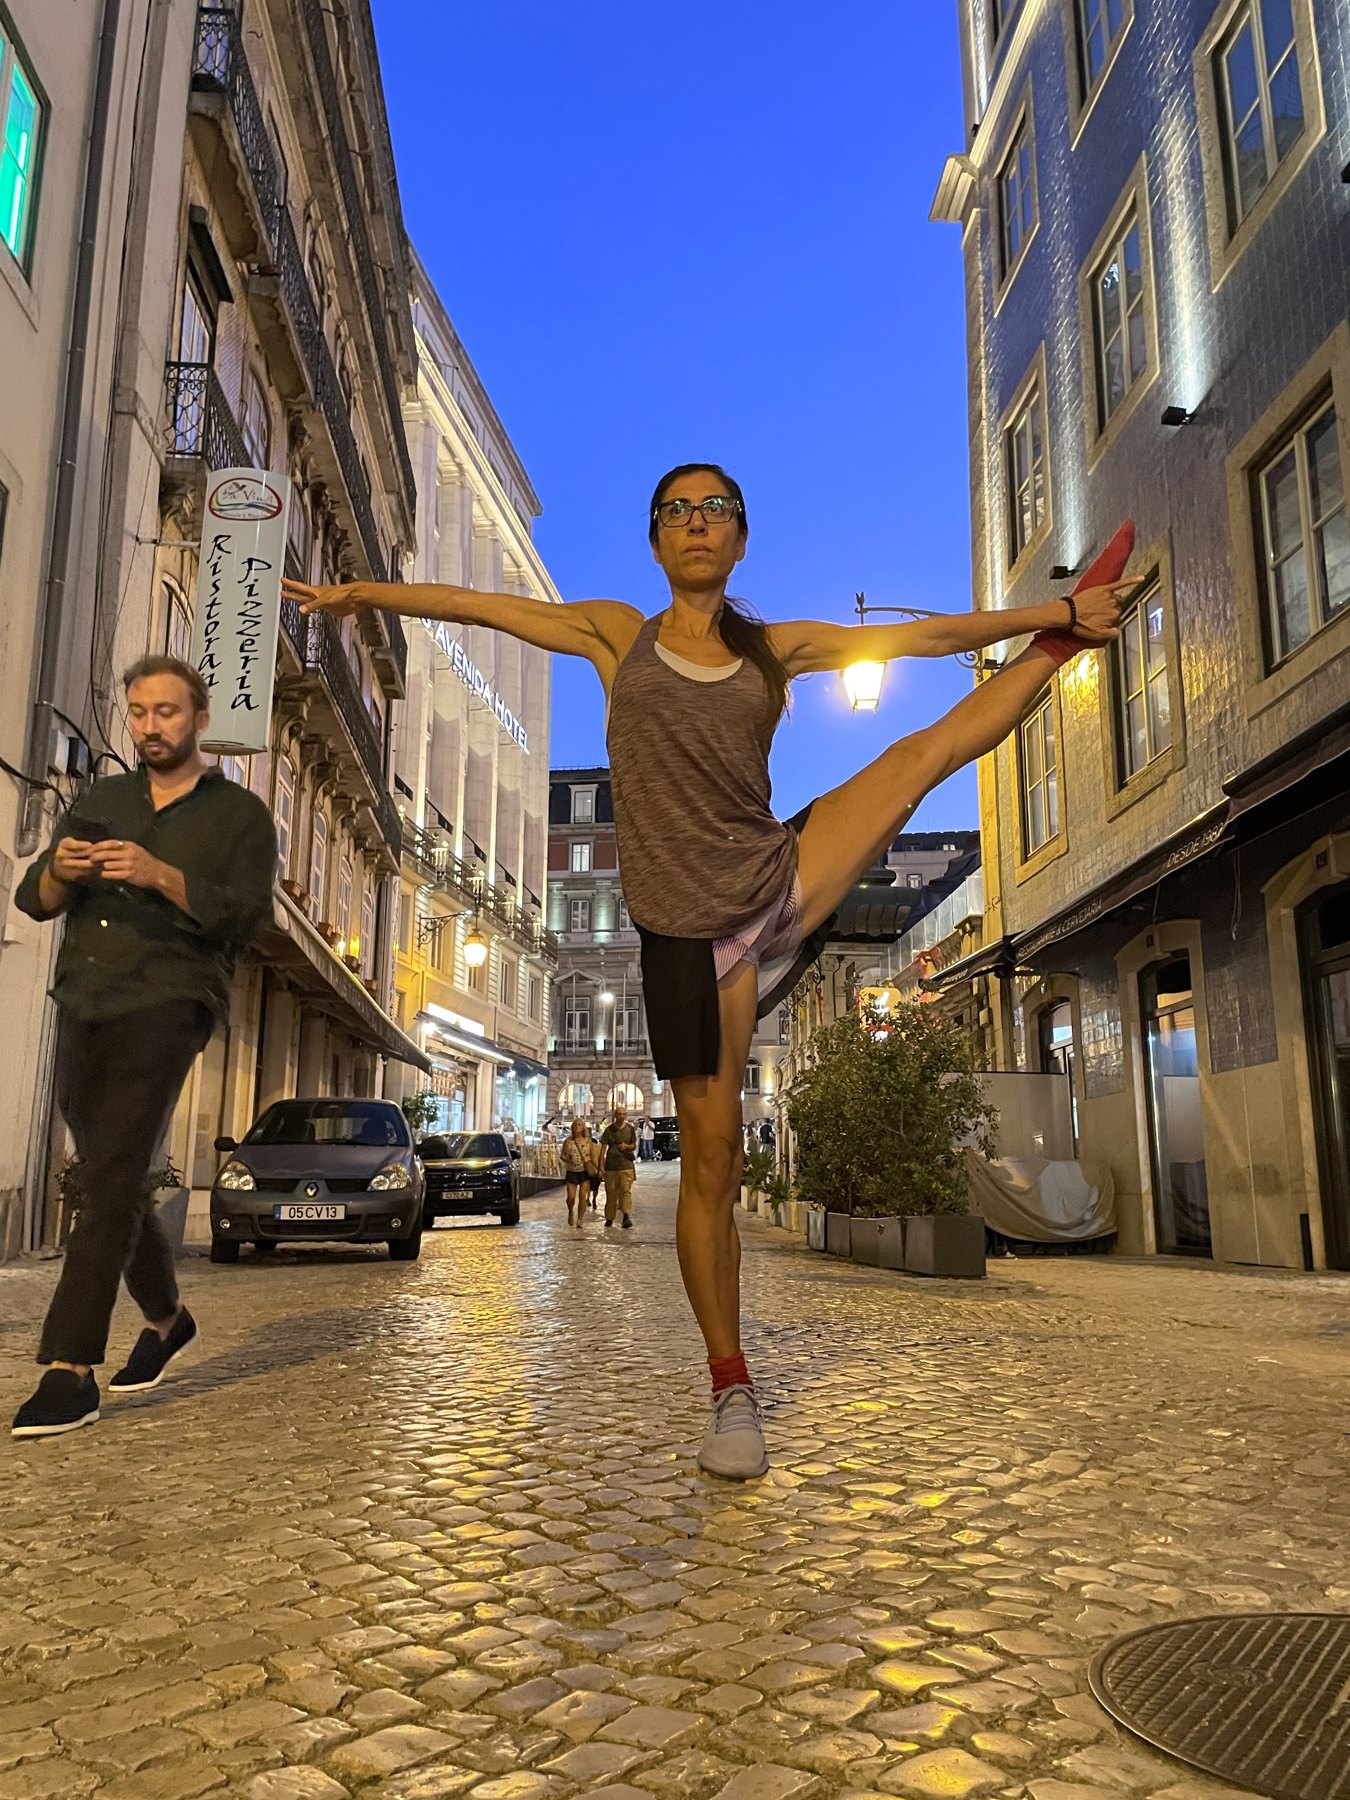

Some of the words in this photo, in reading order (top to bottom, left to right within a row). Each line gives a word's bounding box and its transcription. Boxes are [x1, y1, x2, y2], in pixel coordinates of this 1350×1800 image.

[199, 534, 232, 699] Ristoran
[230, 557, 272, 711] Pizzeria
[434, 620, 493, 706] AVENIDA
[494, 692, 531, 756] HOTEL
[1166, 836, 1201, 868] DESDE
